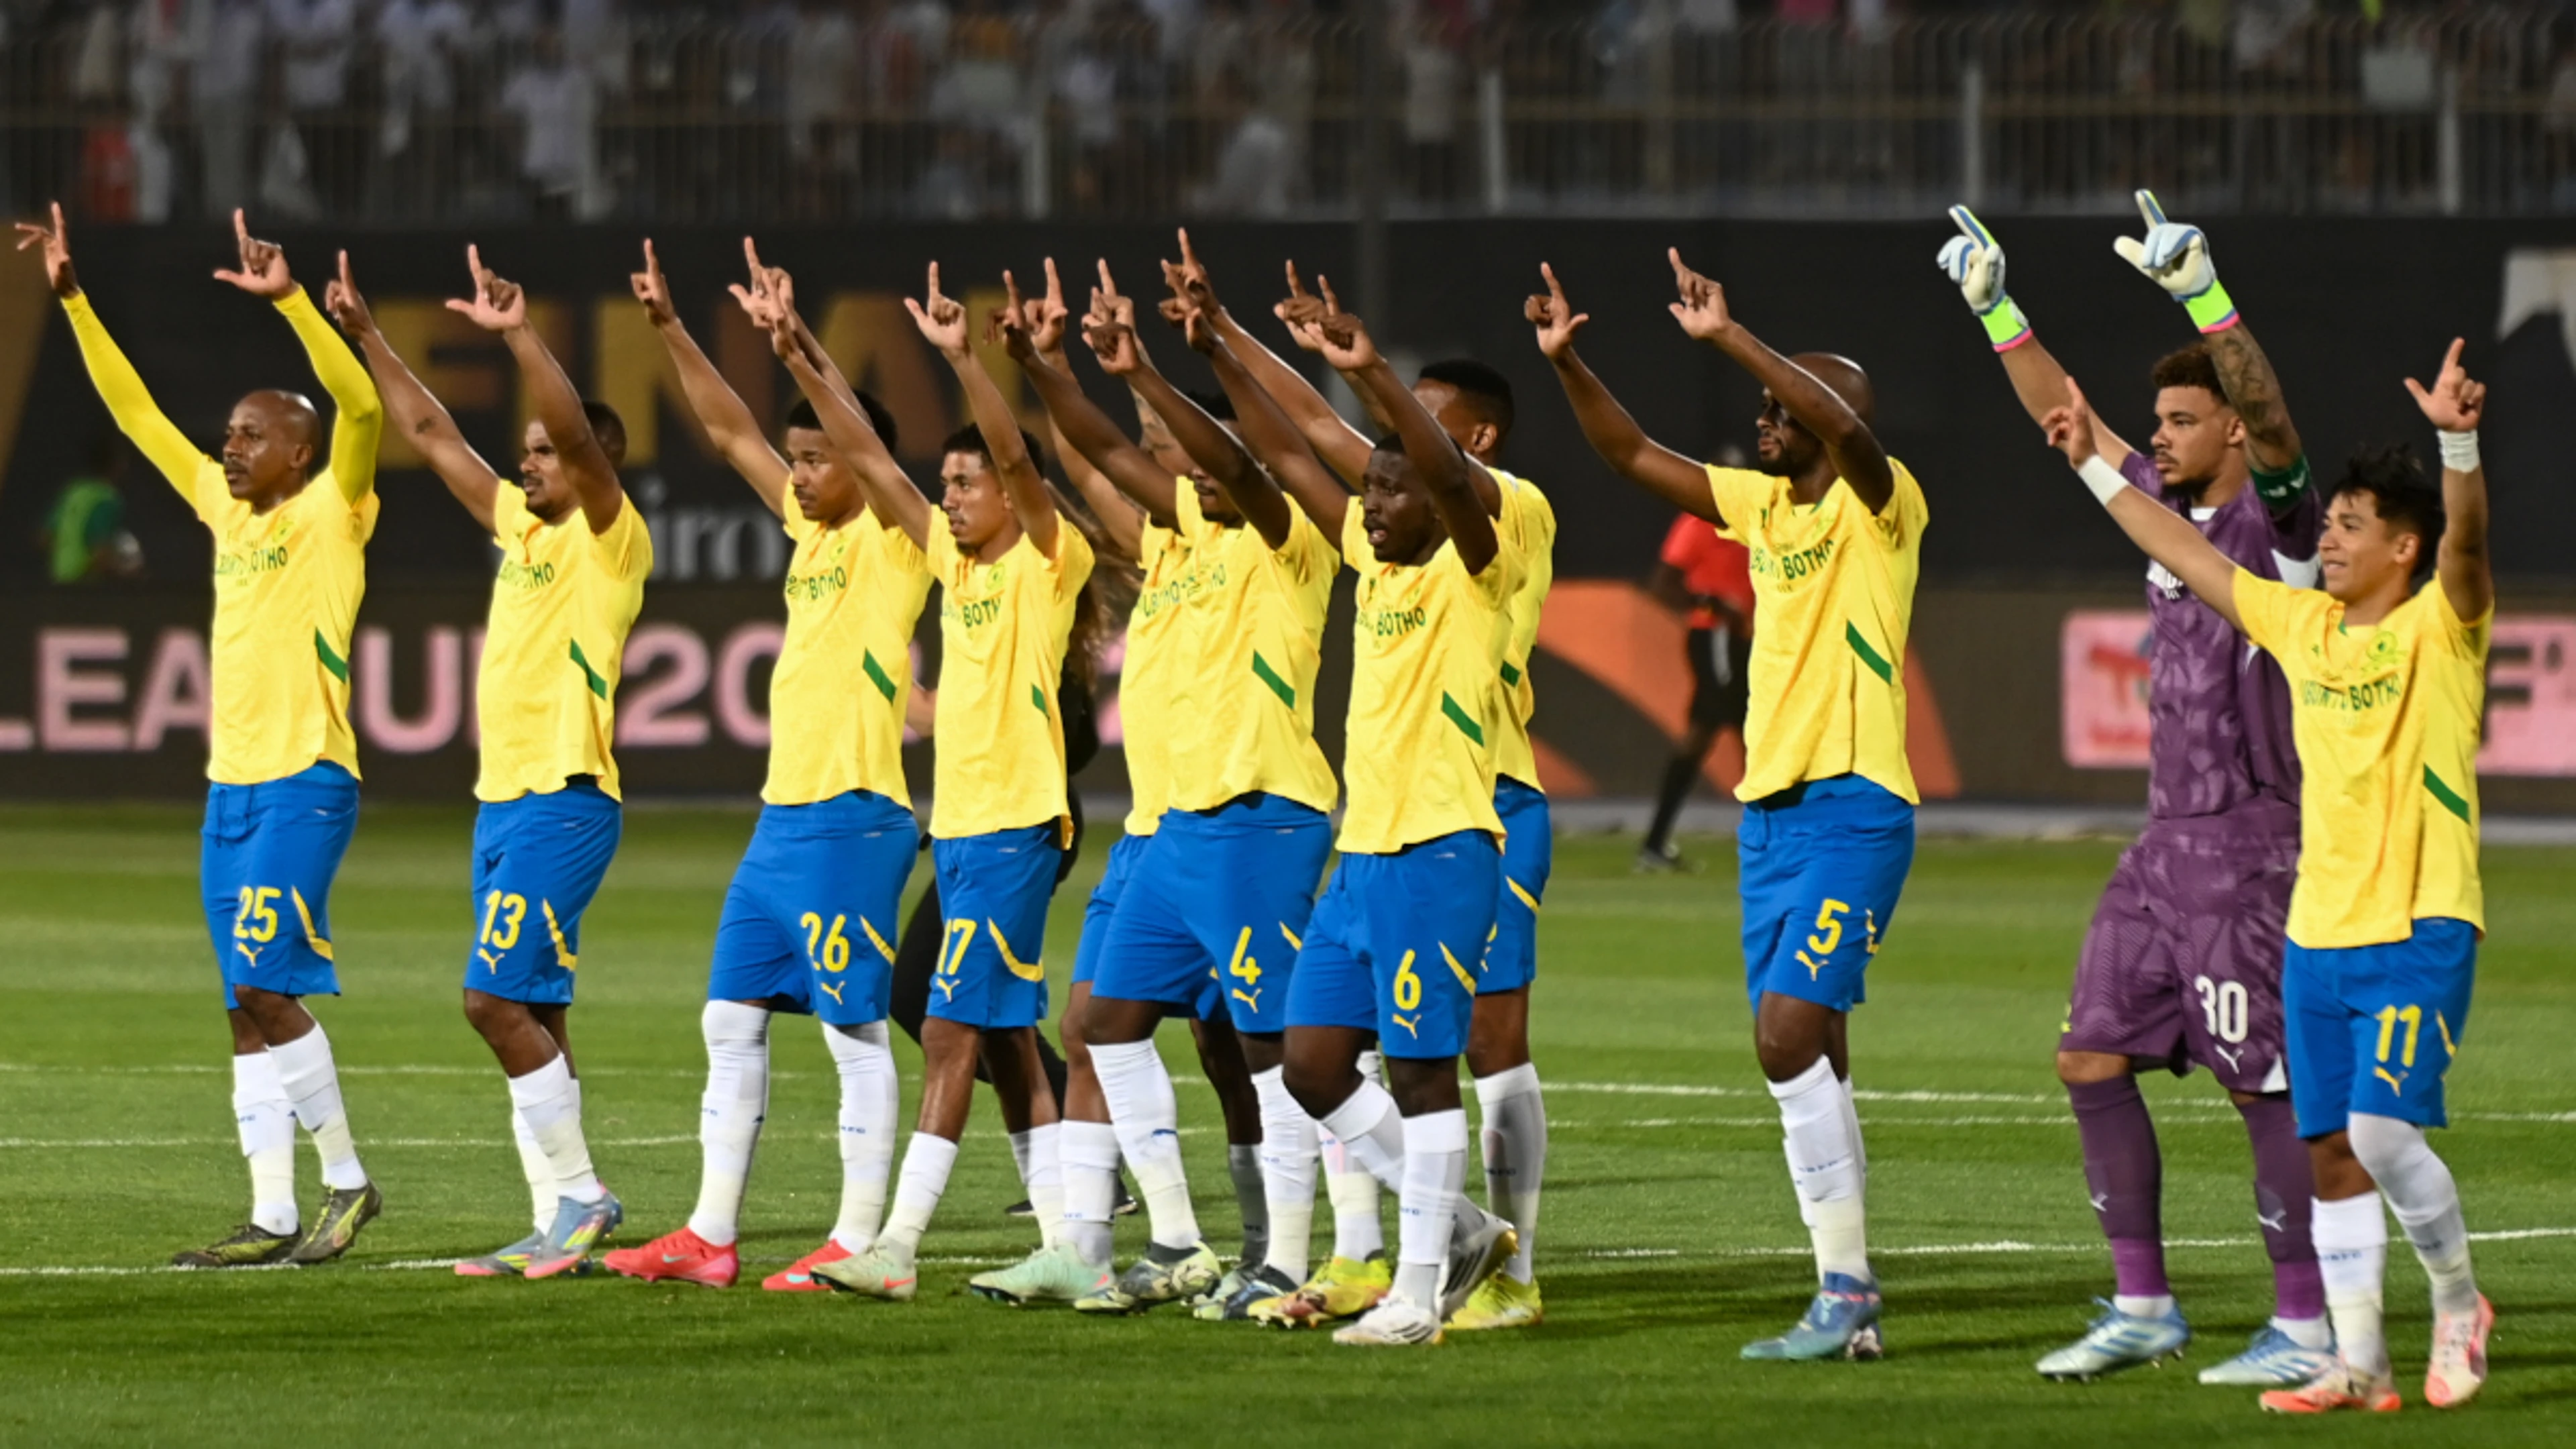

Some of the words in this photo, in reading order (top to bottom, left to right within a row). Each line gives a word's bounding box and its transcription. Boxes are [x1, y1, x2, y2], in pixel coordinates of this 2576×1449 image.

[639, 473, 787, 580] iro
[234, 885, 282, 943] 25
[481, 890, 527, 950] 13
[800, 912, 850, 973] 26
[1807, 898, 1851, 955] 5
[937, 918, 977, 975] 17
[1229, 926, 1263, 985] 4
[1393, 949, 1422, 1011] 6
[2194, 975, 2249, 1044] 30
[2373, 1004, 2422, 1068] 11
